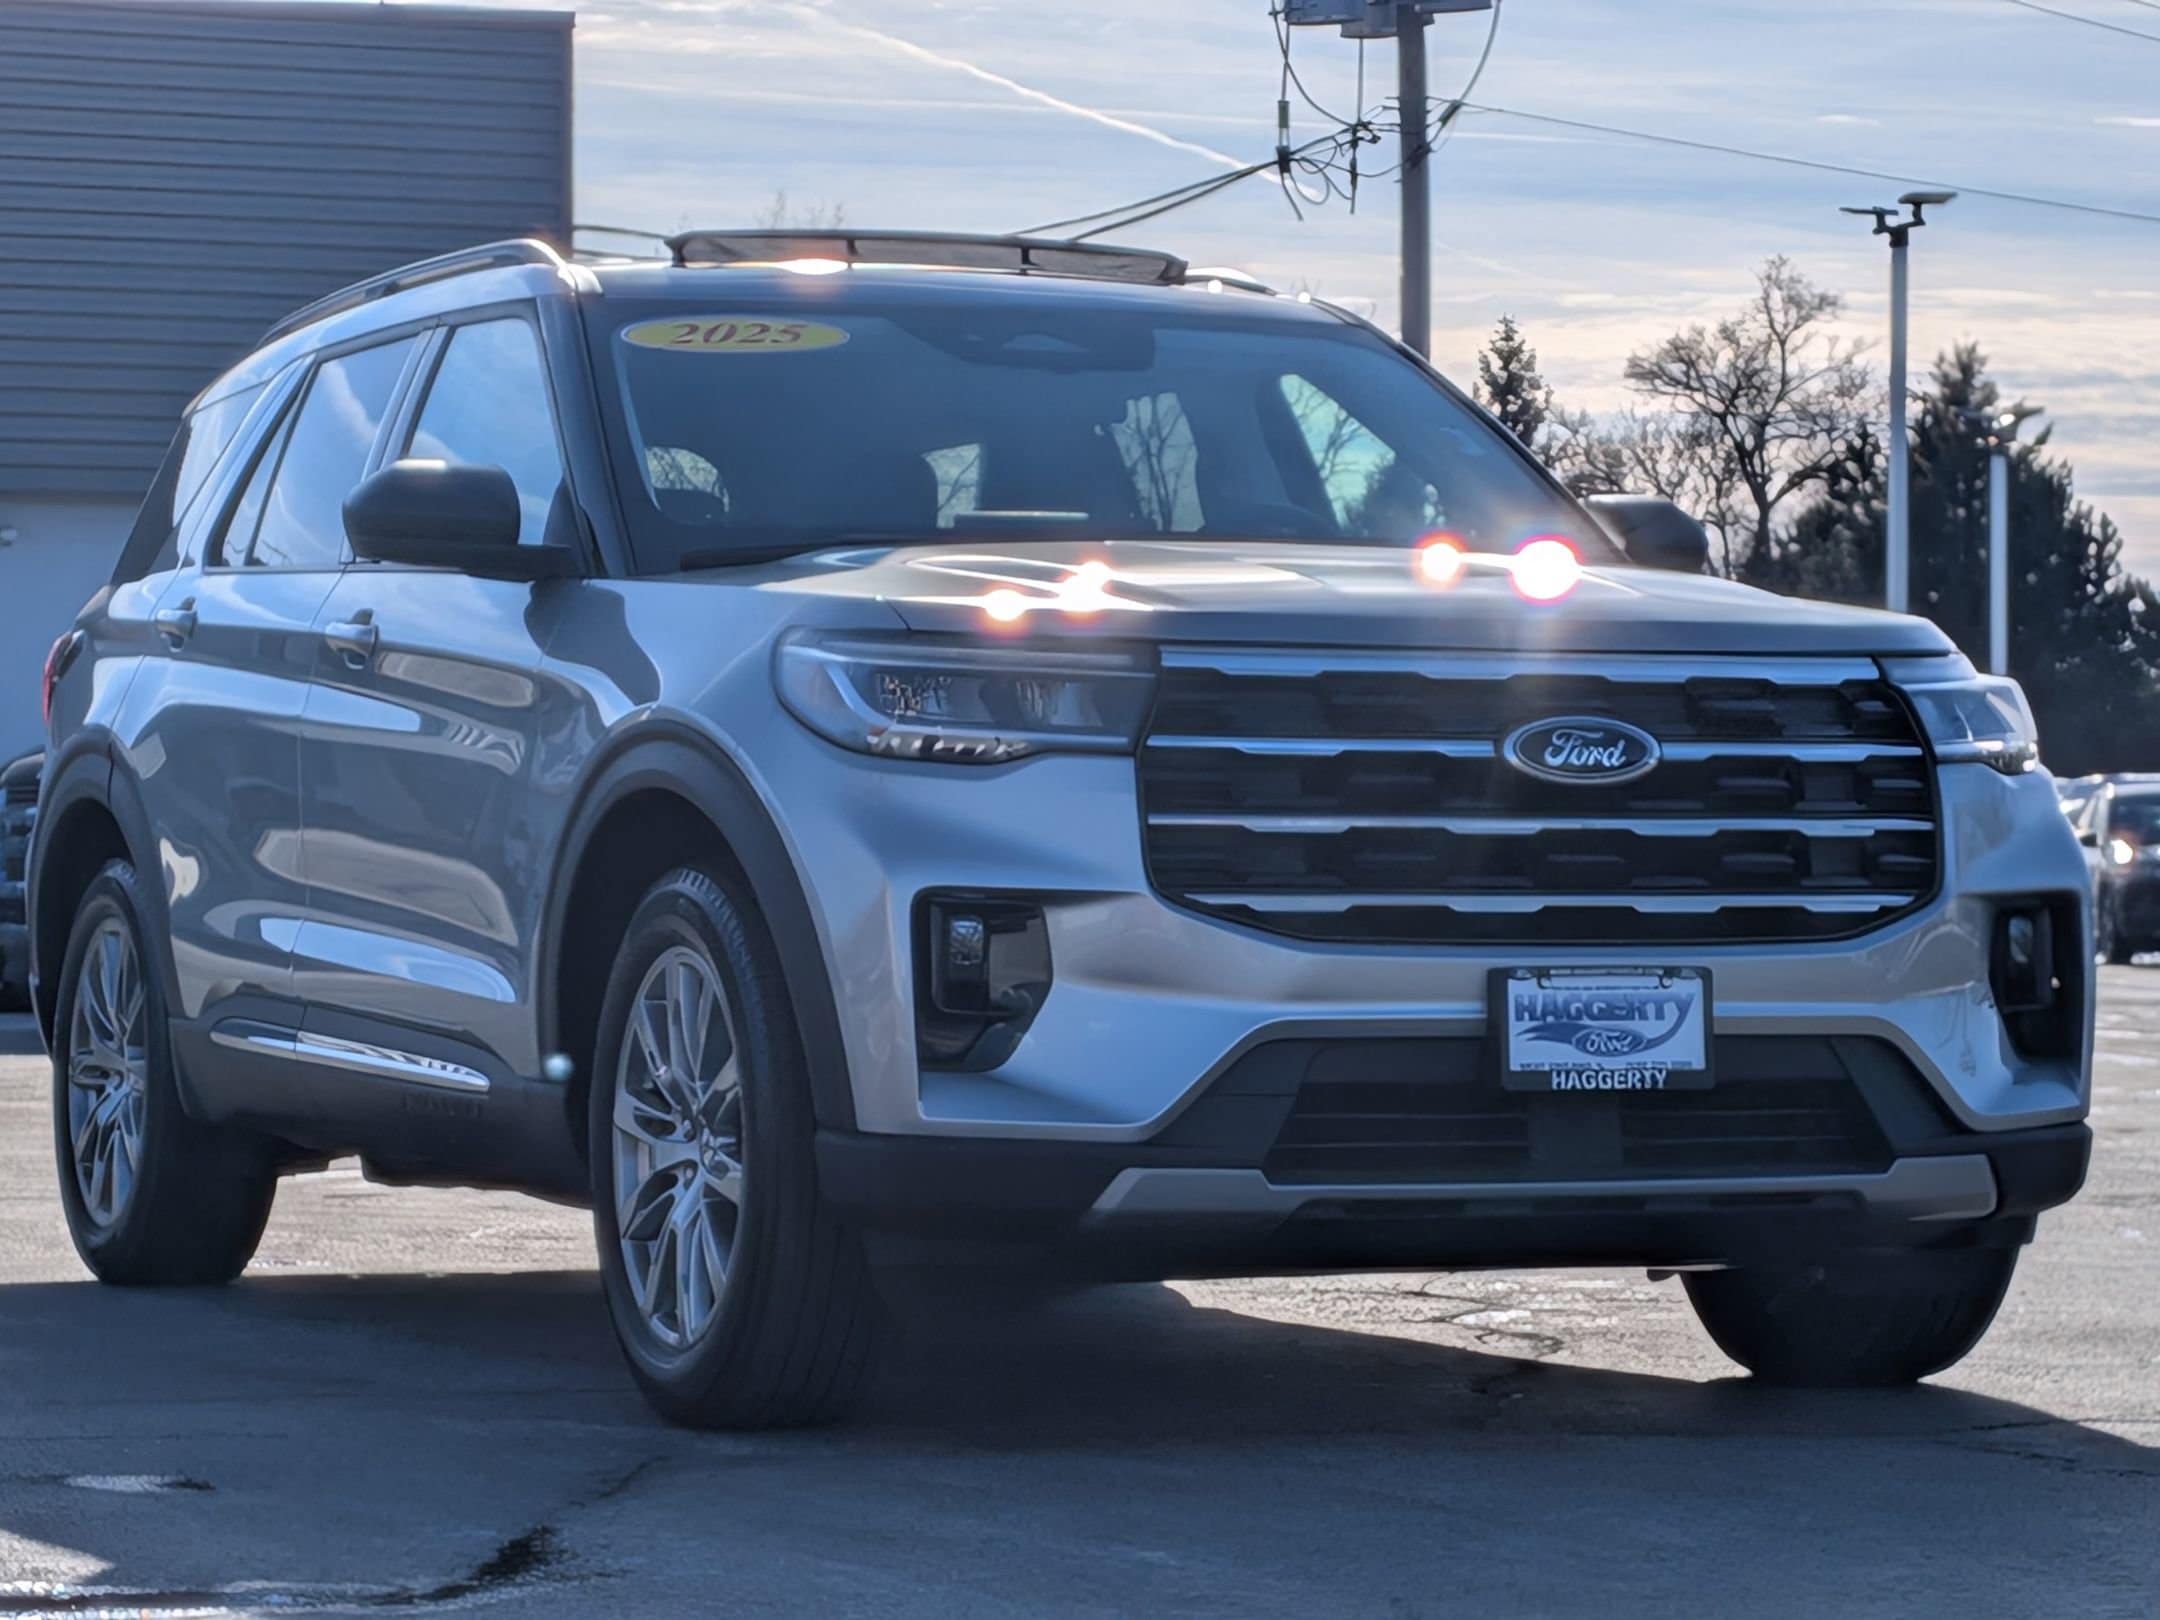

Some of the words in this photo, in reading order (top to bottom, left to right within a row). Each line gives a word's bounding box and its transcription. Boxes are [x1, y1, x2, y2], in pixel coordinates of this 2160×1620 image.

[671, 322, 808, 344] 2025
[1544, 728, 1627, 767] Ford
[1514, 992, 1696, 1022] HAGGERTY
[1551, 1070, 1667, 1090] HAGGERTY
